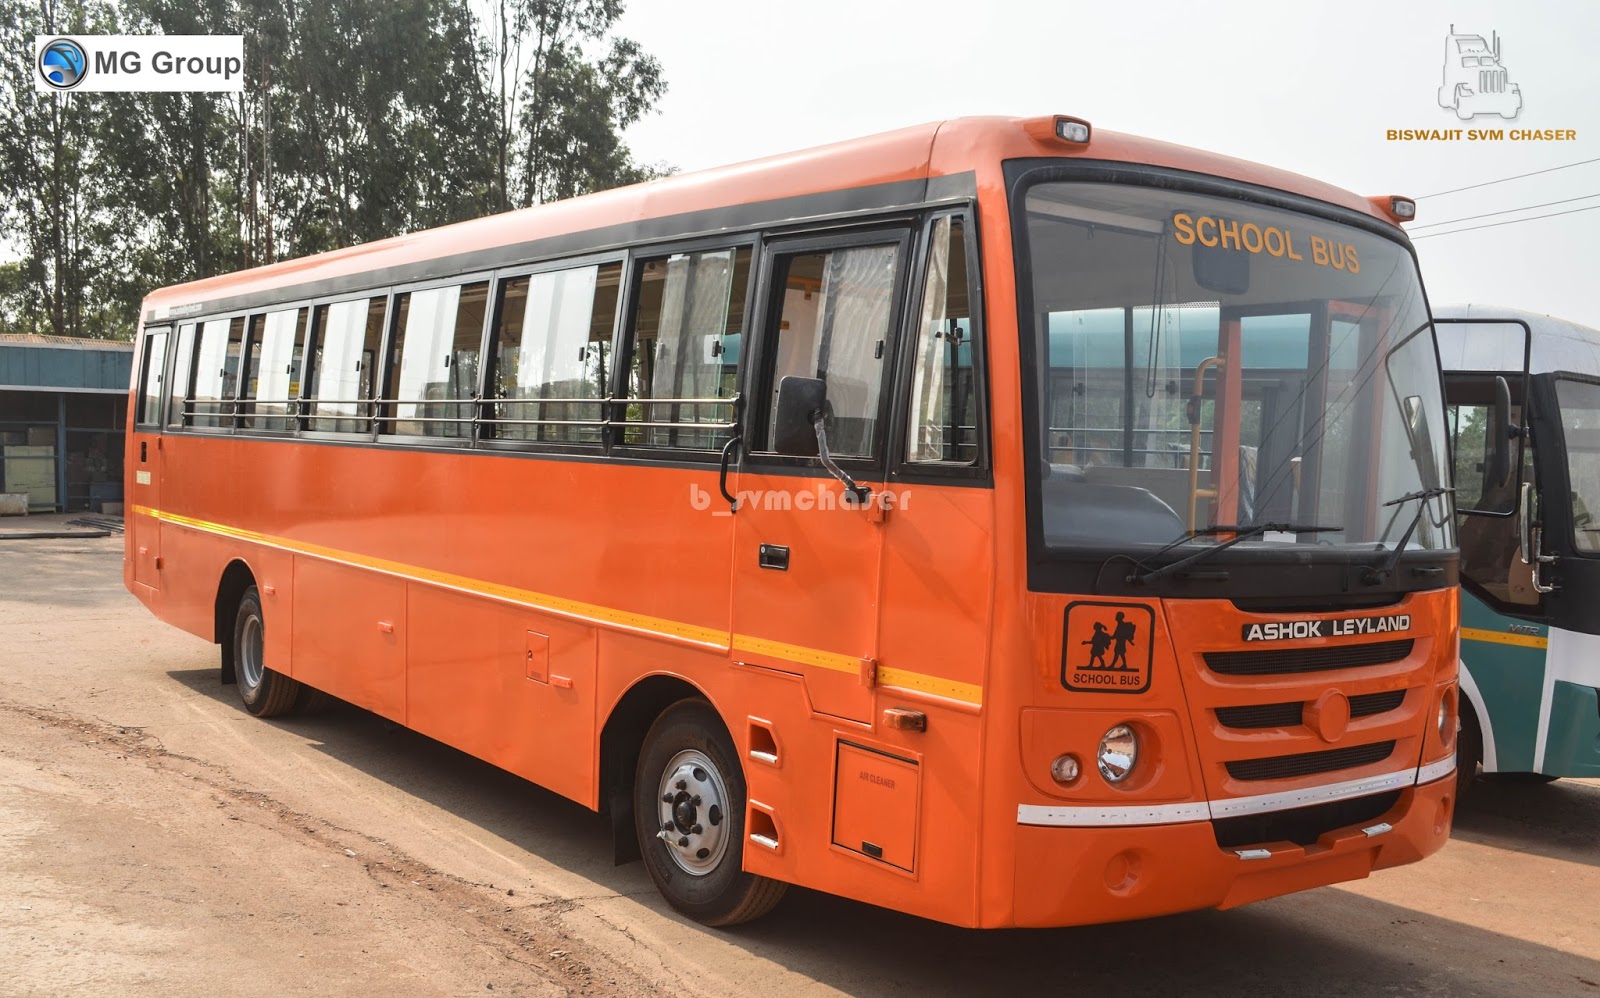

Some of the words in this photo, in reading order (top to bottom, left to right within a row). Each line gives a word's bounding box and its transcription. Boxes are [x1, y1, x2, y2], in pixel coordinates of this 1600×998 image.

[1173, 213, 1303, 261] SCHOOL
[1310, 235, 1361, 274] BUS
[1247, 620, 1322, 641] ASHOK
[1333, 615, 1410, 636] LEYLAND
[1073, 673, 1117, 685] SCHOOL
[1120, 675, 1140, 686] BUS
[860, 771, 869, 781] AIR
[869, 774, 896, 789] CLEANER
